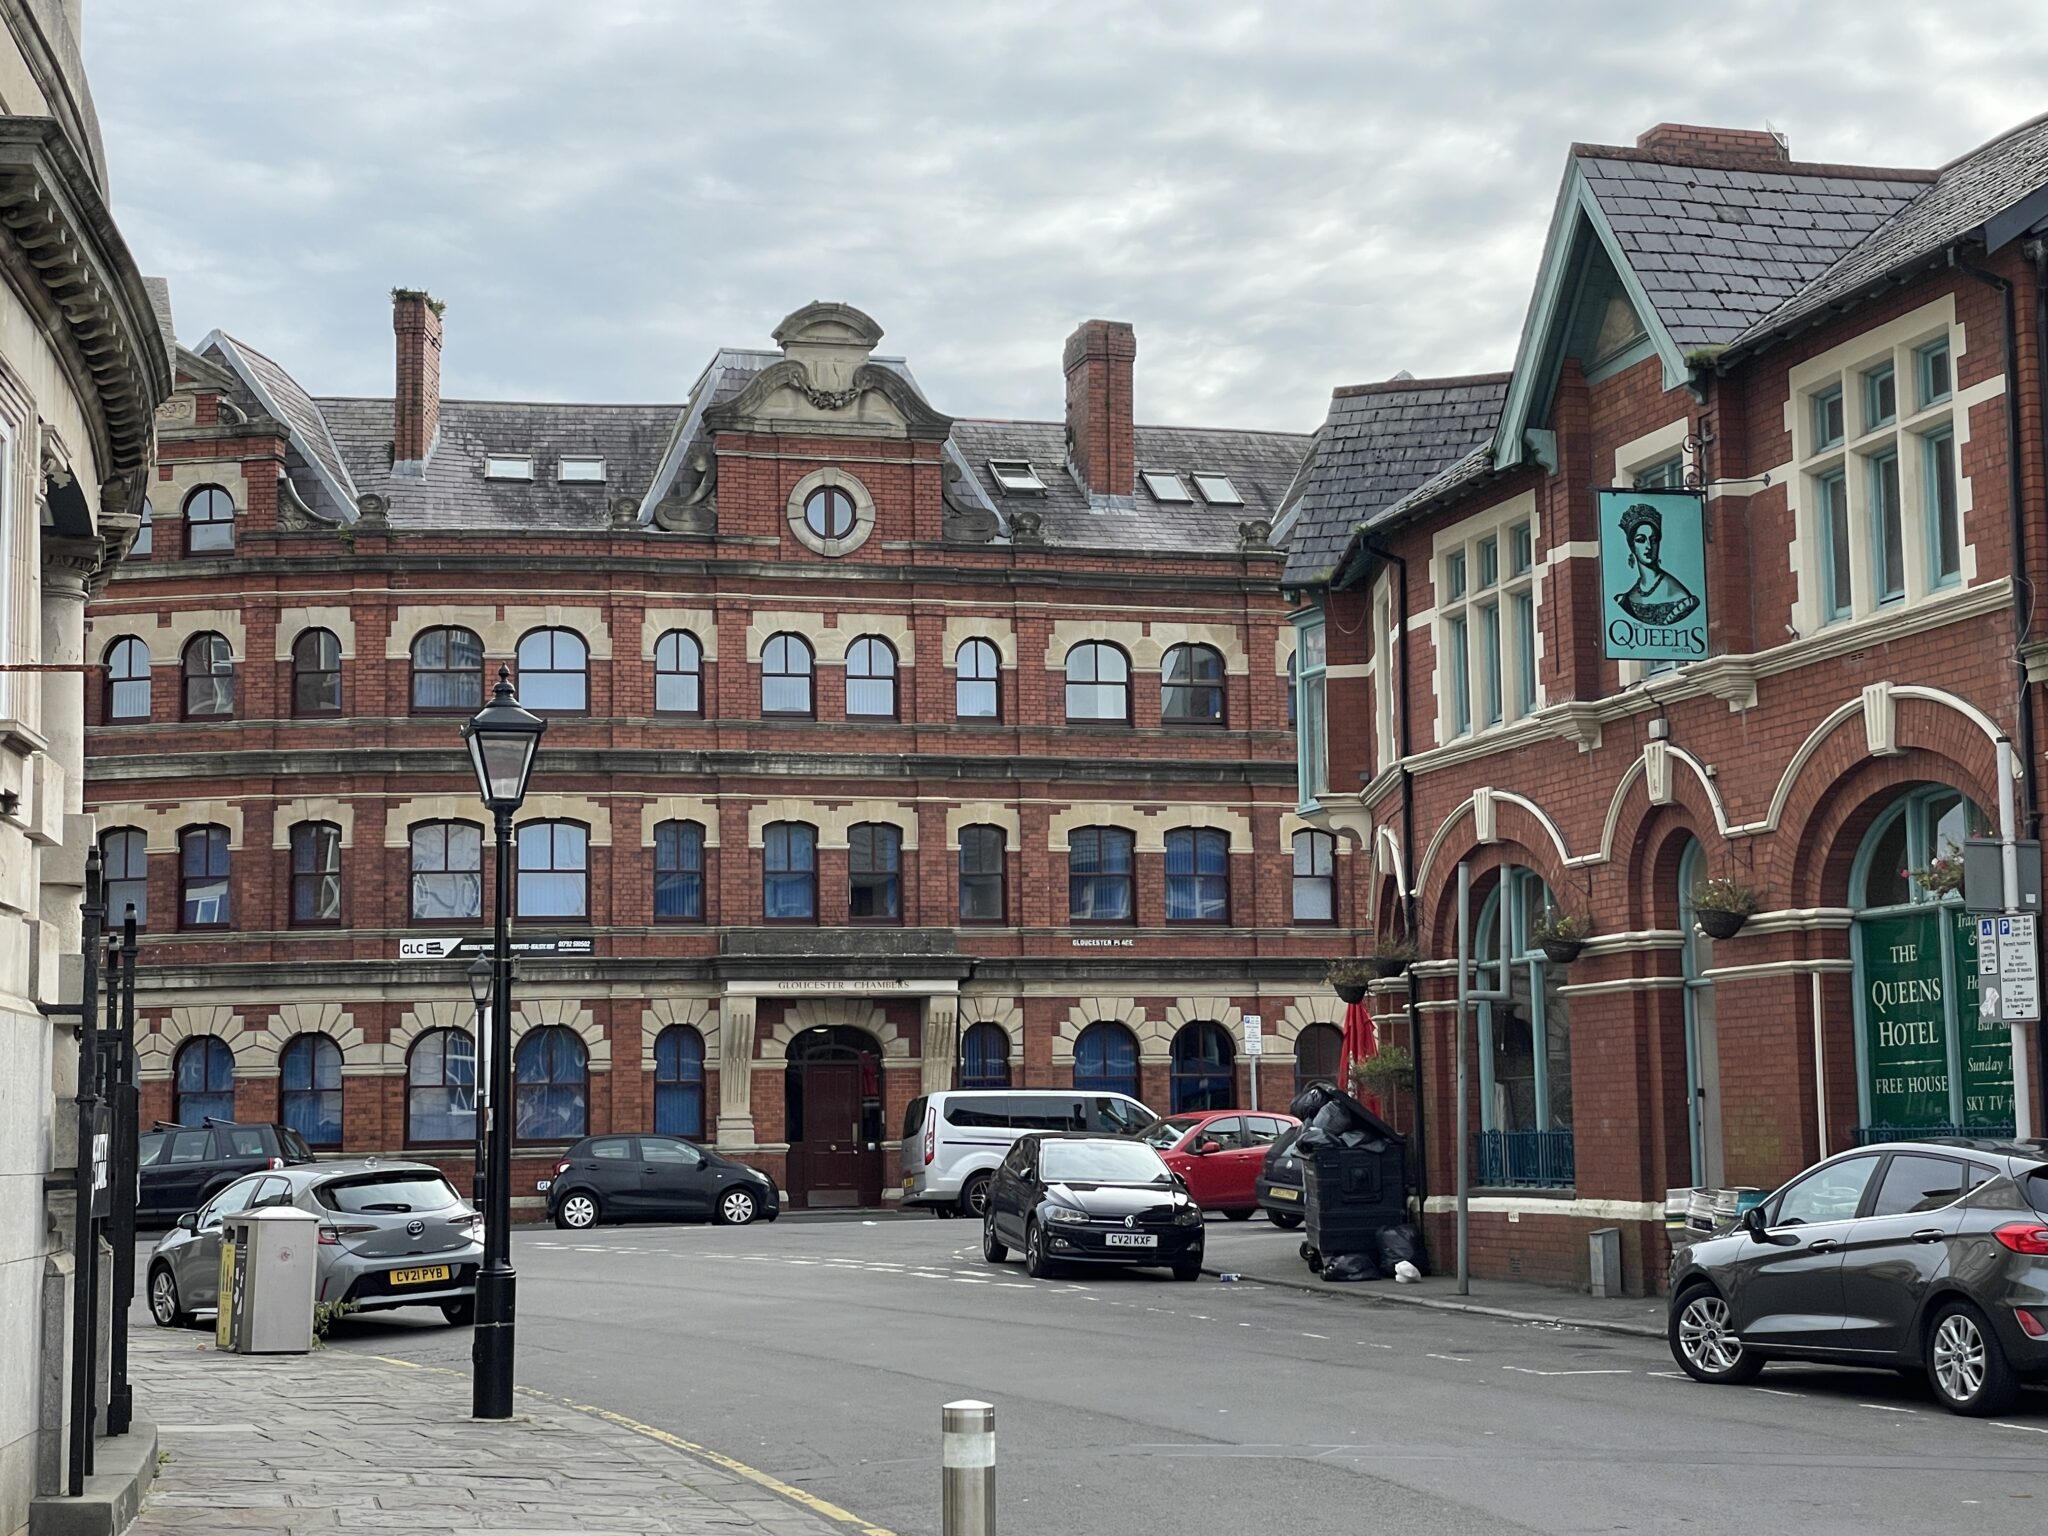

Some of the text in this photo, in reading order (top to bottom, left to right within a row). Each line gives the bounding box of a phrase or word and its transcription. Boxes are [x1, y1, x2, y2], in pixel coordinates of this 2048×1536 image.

[2002, 921, 2008, 934] P
[402, 943, 424, 955] GLC
[1072, 939, 1112, 947] GLOUCESTER
[1889, 944, 1918, 964] THE
[778, 980, 910, 991] GLOUCESTER CHAMBERS
[1872, 977, 1942, 1014] QUEENS
[1878, 1022, 1940, 1047] HOTEL
[1967, 1055, 2004, 1075] Sunday
[1875, 1075, 1949, 1095] FREE HOUSE
[1966, 1095, 1985, 1112] SKY
[1989, 1095, 2003, 1111] TV
[1111, 1234, 1152, 1245] CV21 KXF
[396, 1267, 443, 1283] CV21 PYB
